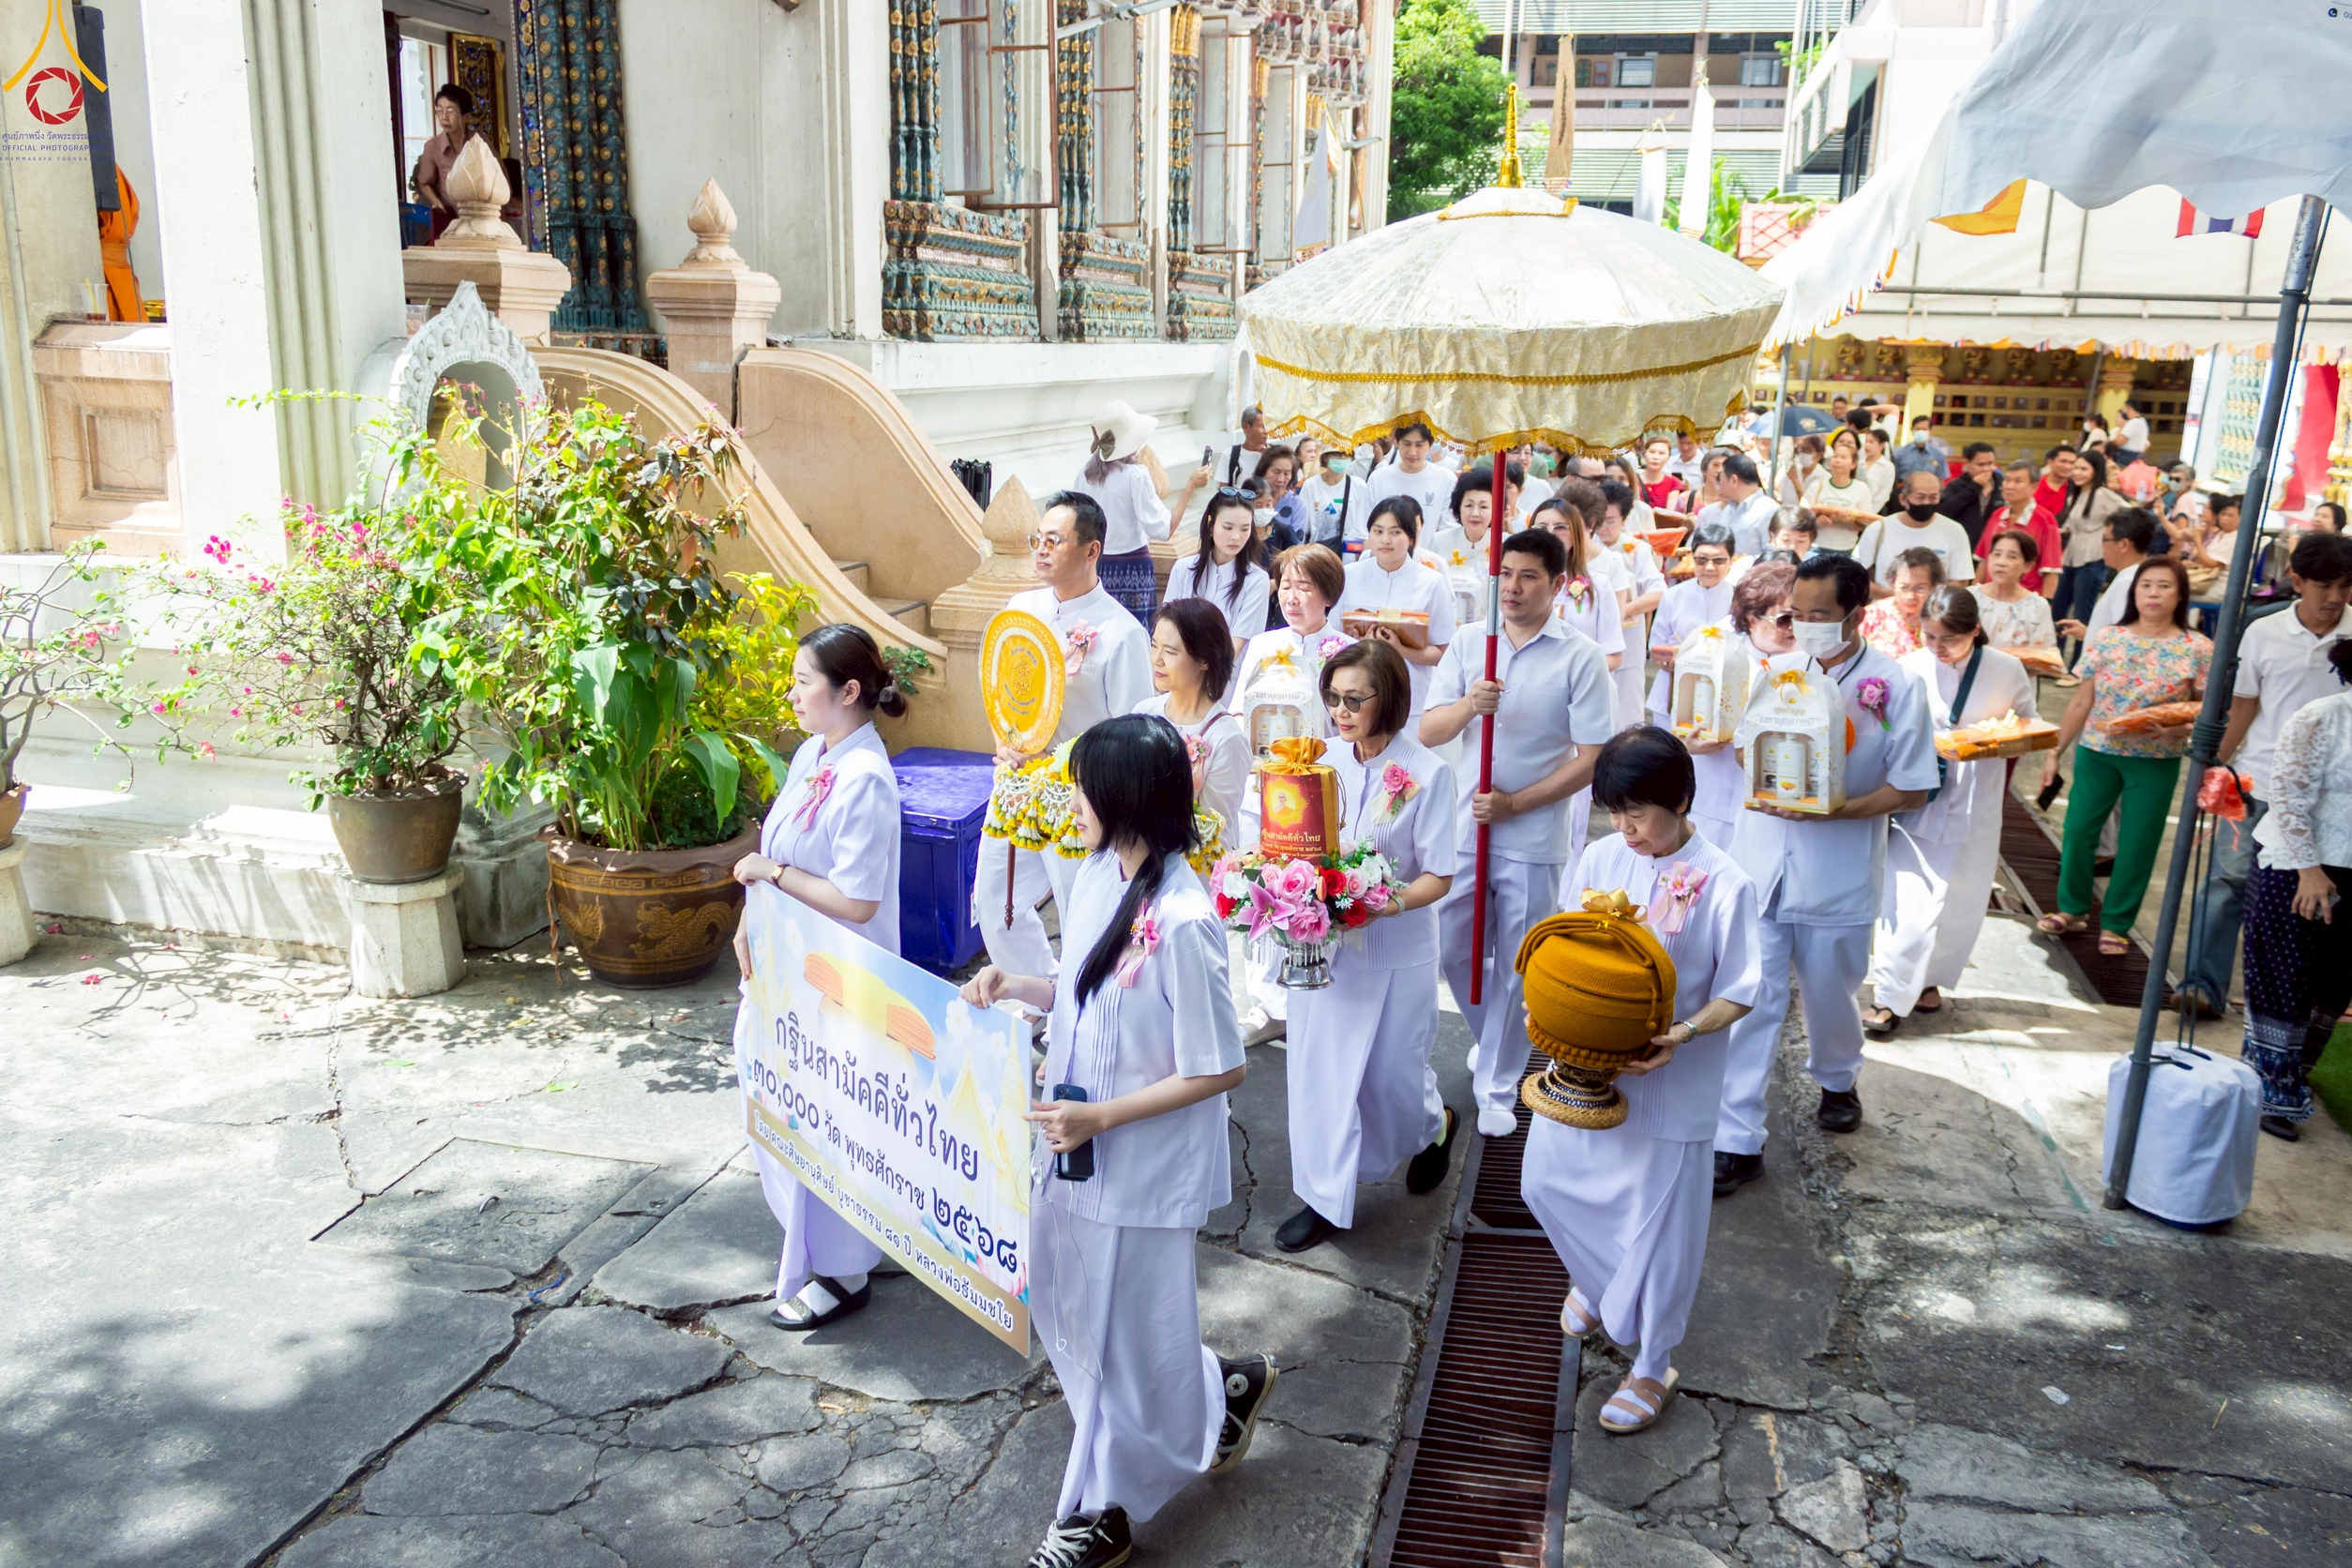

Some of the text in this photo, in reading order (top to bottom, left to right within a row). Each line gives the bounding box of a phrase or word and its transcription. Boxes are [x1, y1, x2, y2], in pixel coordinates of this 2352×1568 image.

[753, 1058, 1018, 1274] ๓๐,๐๐๐ วัด พุทธศักราช ๒๕๖๘
[776, 1010, 978, 1182] กฐินสามัคคีทั่วไทย
[755, 1111, 769, 1138] โดย
[837, 1186, 882, 1233] บูชาธรรม
[903, 1233, 912, 1257] ปี
[915, 1248, 1012, 1330] หลวงพ่อธัมมชโย
